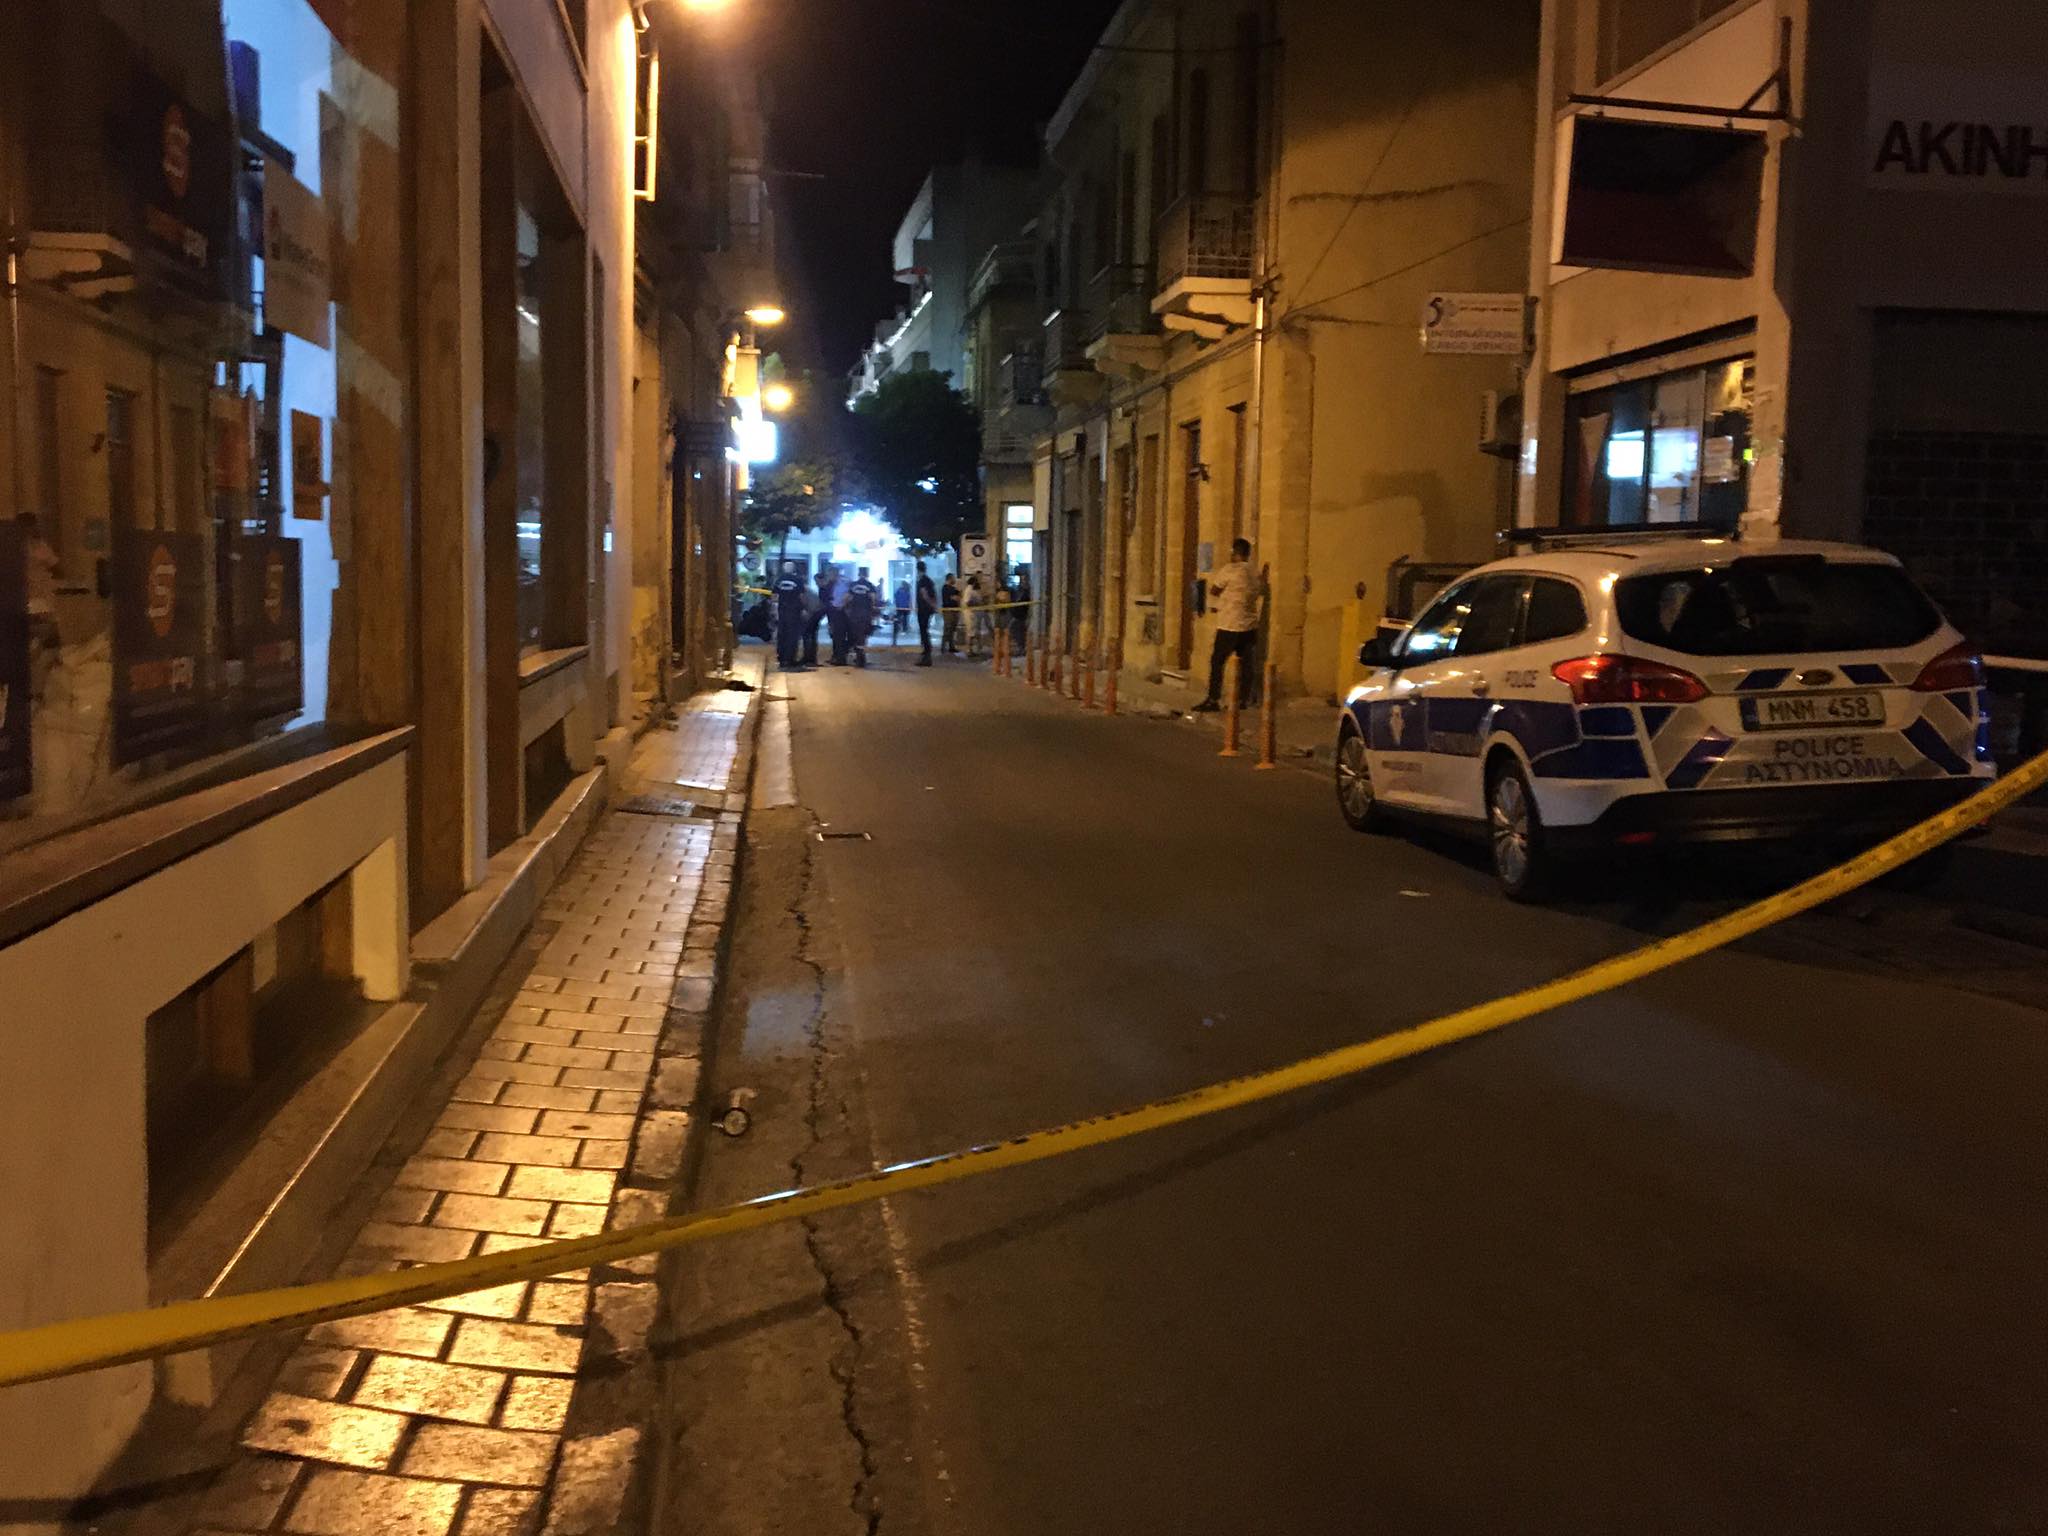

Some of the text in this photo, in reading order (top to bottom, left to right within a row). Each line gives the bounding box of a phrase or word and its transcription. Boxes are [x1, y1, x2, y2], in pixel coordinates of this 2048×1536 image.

[1768, 696, 1870, 721] MNM 458
[1775, 736, 1864, 758] POLICE
